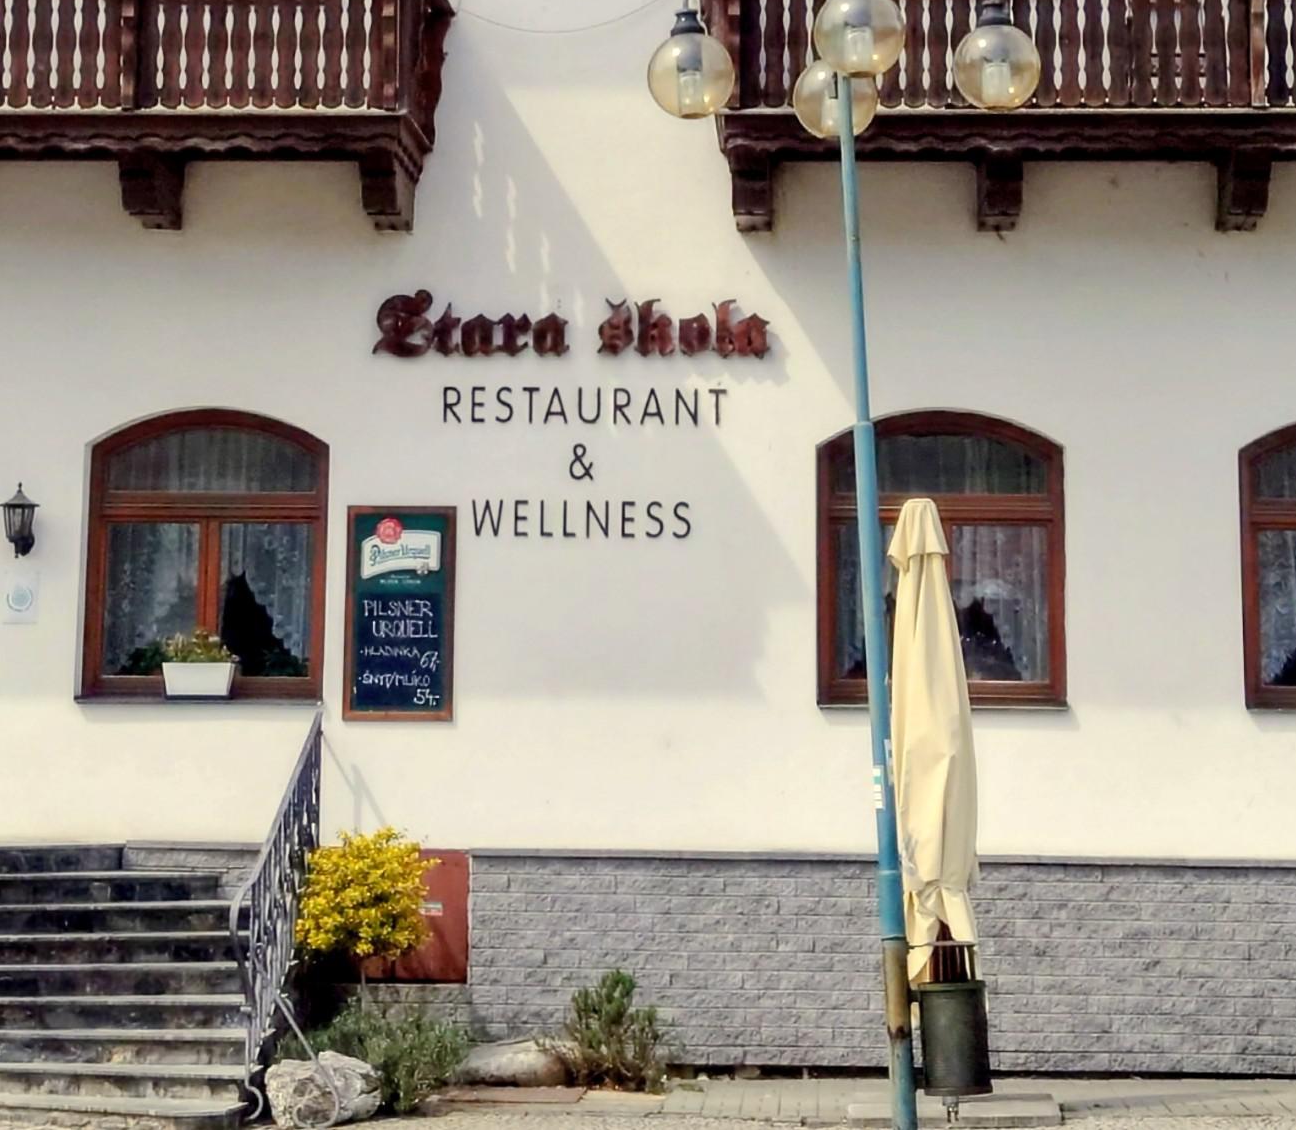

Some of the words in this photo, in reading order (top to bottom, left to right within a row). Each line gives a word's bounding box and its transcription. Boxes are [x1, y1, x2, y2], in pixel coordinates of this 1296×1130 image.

[443, 386, 728, 426] RESTAURANT
[568, 443, 595, 481] &
[471, 499, 692, 539] WELLNESS
[363, 599, 434, 617] PILSNER
[372, 619, 438, 638] URQUELL
